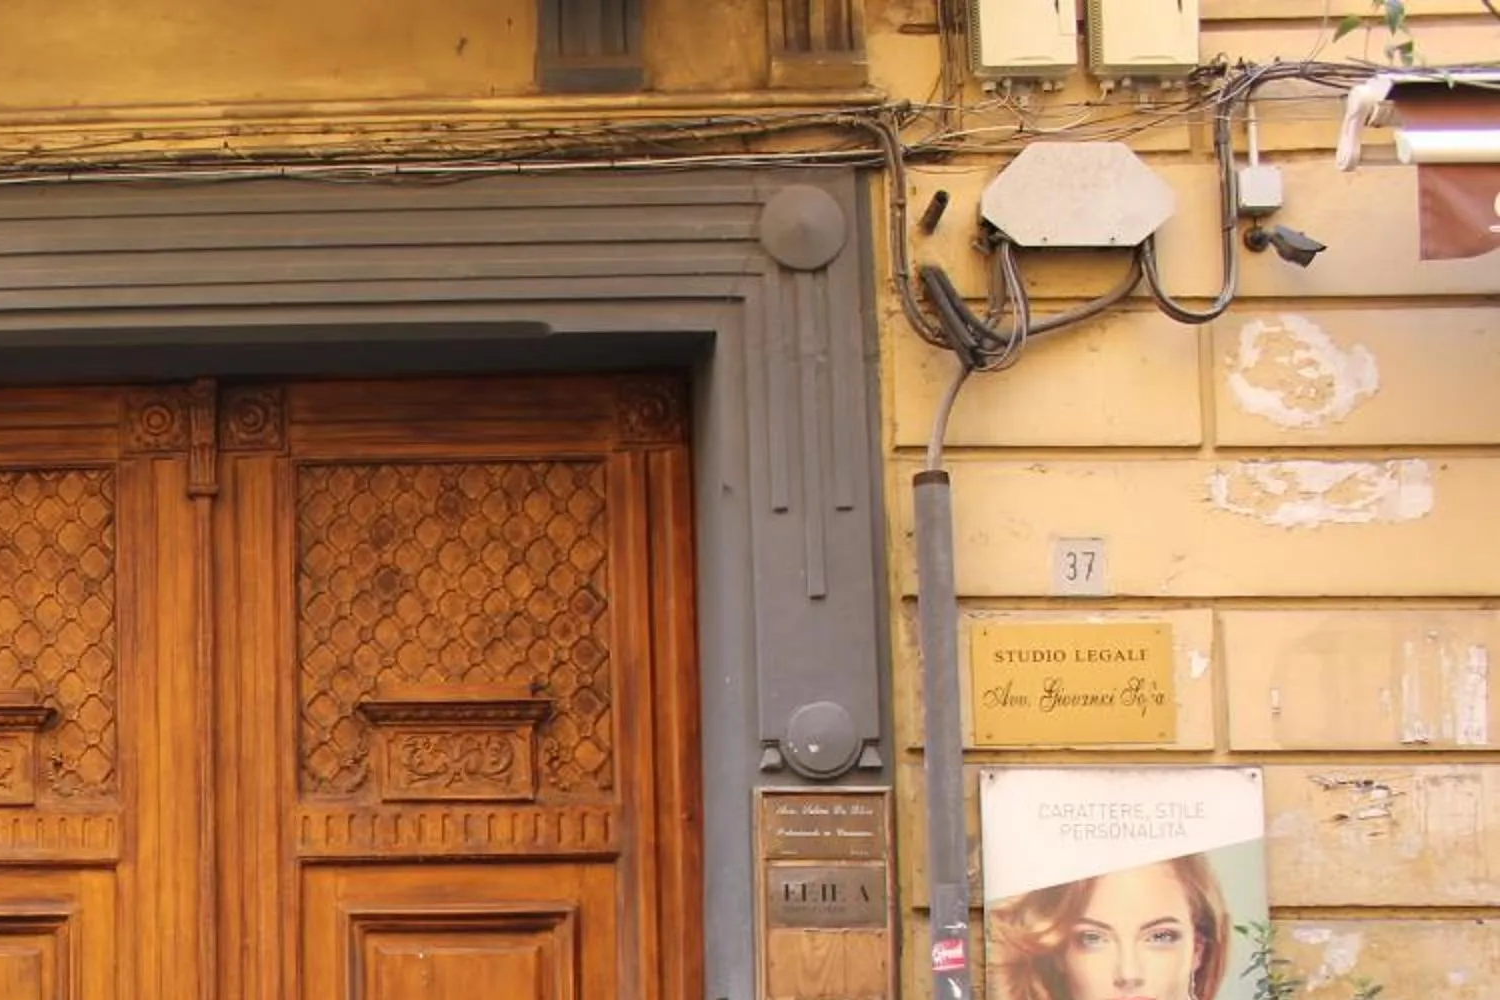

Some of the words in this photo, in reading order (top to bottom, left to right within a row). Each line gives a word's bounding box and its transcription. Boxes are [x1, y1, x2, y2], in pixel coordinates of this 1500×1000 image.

[1065, 551, 1096, 583] 37
[994, 648, 1067, 663] STUDIO
[1075, 648, 1149, 662] LEGALE
[1156, 801, 1205, 819] STILE
